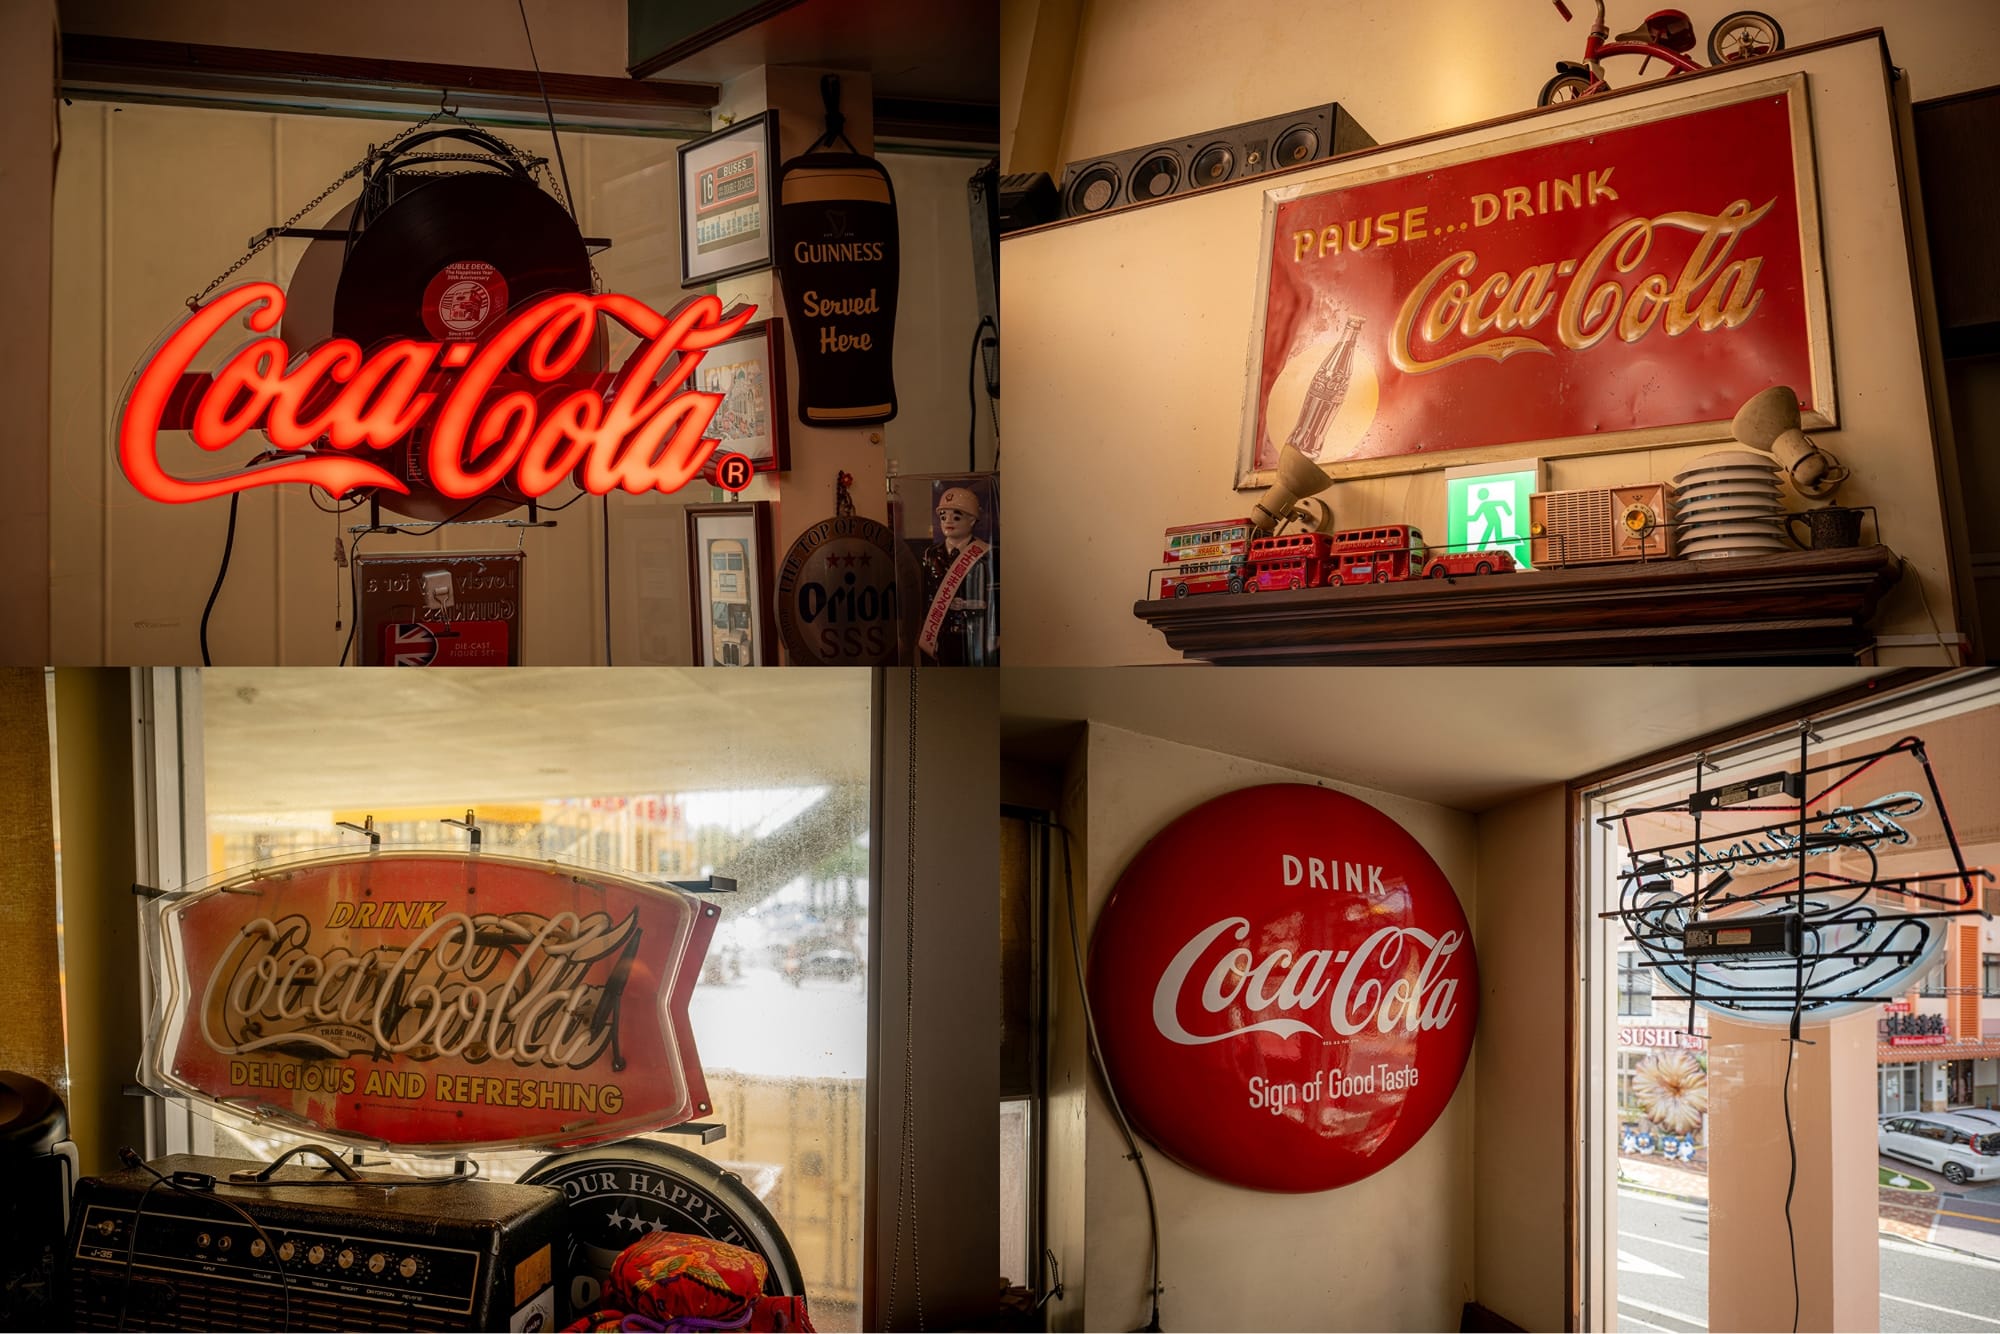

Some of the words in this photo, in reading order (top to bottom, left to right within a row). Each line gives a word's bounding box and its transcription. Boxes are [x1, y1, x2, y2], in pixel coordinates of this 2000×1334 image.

[703, 174, 713, 204] 16
[724, 160, 747, 177] BUSES
[1472, 166, 1620, 228] DRINK
[794, 241, 884, 264] GUINNESS
[803, 288, 880, 317] Served
[1388, 196, 1778, 375] Coca-Cola
[820, 326, 873, 354] Here
[119, 281, 758, 504] Coca-Cola
[779, 552, 802, 593] THE
[797, 522, 830, 554] TOP
[835, 518, 858, 535] OF
[455, 642, 491, 650] DIE-CAST
[820, 626, 885, 658] SSS
[1282, 854, 1387, 896] DRINK
[325, 900, 448, 929] DRINK
[203, 905, 641, 1070] Coca-Cola
[1152, 916, 1464, 1045] Coca-Cola
[320, 1028, 344, 1037] TRADE
[345, 1030, 366, 1043] MARK
[231, 1060, 356, 1095] DELICIOUS
[364, 1071, 426, 1100] AND
[435, 1075, 625, 1115] REFRESHING
[1249, 1076, 1297, 1115] Sign
[1302, 1070, 1324, 1103] of
[1328, 1065, 1375, 1099] Good
[1378, 1064, 1419, 1092] Taste
[563, 1172, 620, 1200] OUR
[628, 1172, 722, 1226] HAPPY
